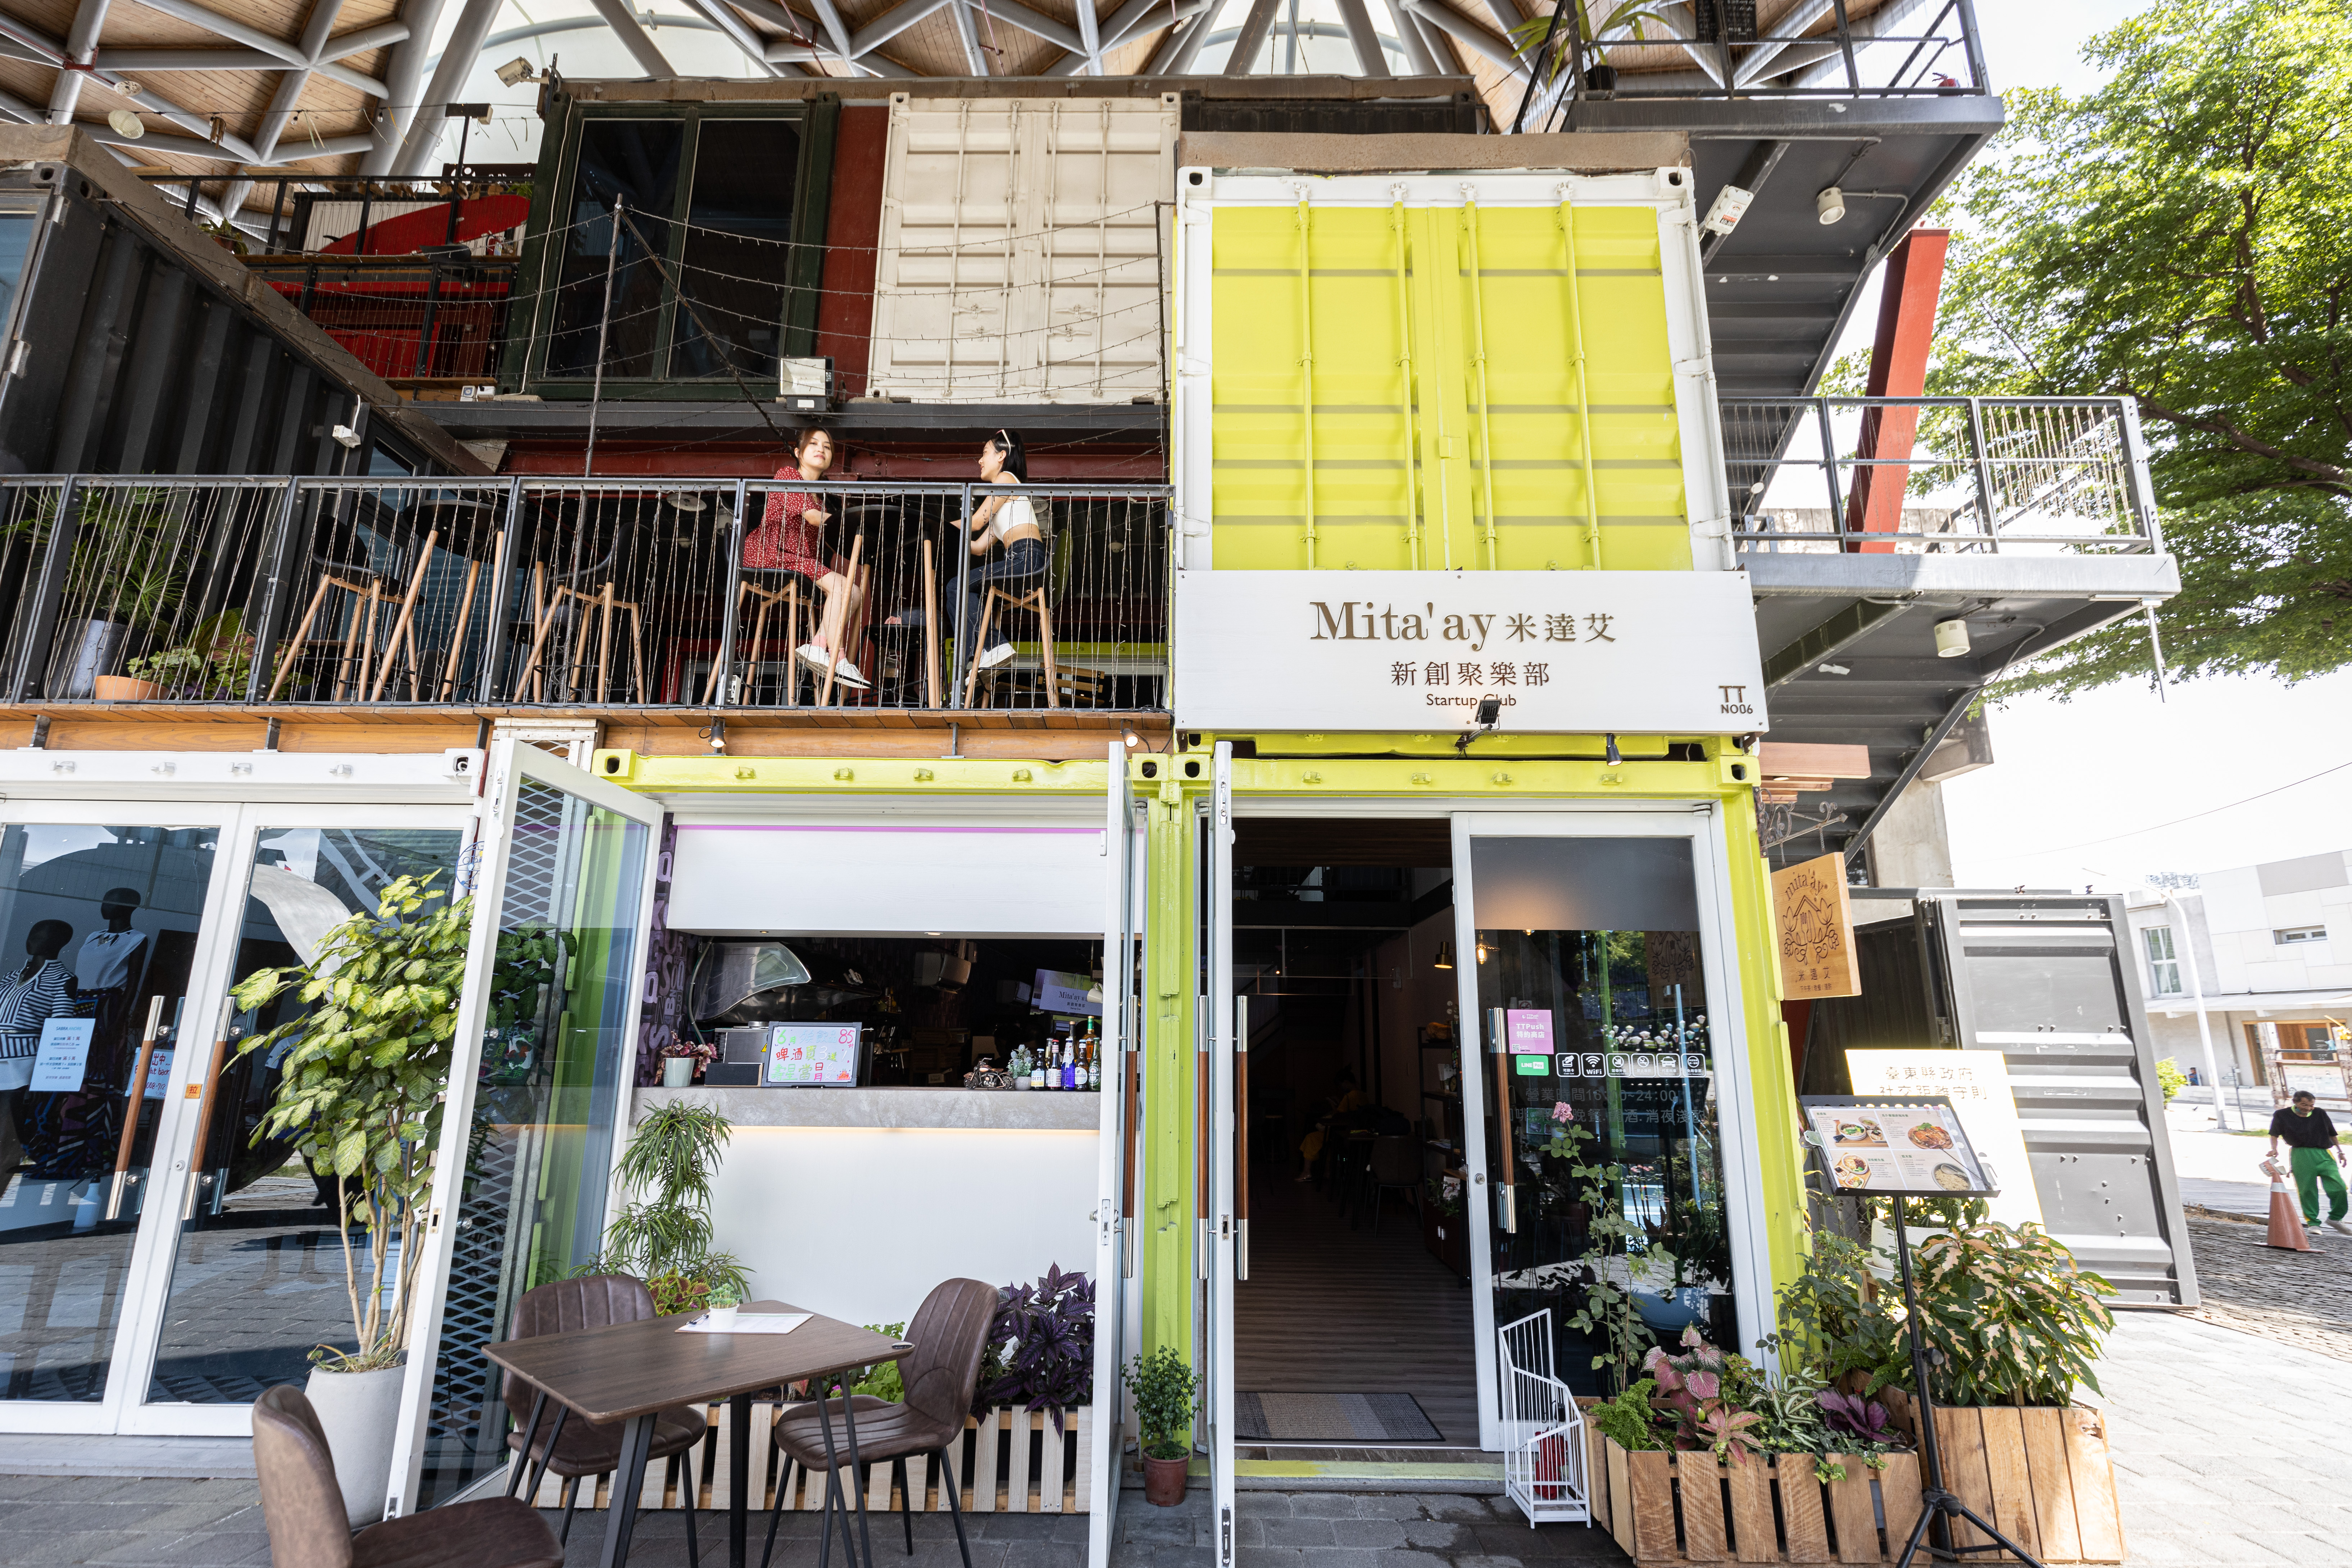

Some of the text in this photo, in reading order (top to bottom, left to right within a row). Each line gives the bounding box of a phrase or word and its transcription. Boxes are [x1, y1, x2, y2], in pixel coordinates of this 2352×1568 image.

[1309, 602, 1616, 651] Mita'ay 米達艾
[1391, 661, 1549, 686] 新創聚樂部
[1426, 694, 1477, 709] Startup
[1721, 704, 1753, 714] NO06
[1059, 991, 1081, 1002] Mita'ay
[1885, 1067, 1972, 1080] 臺東縣政府
[1879, 1085, 1987, 1099] 社交距離守則
